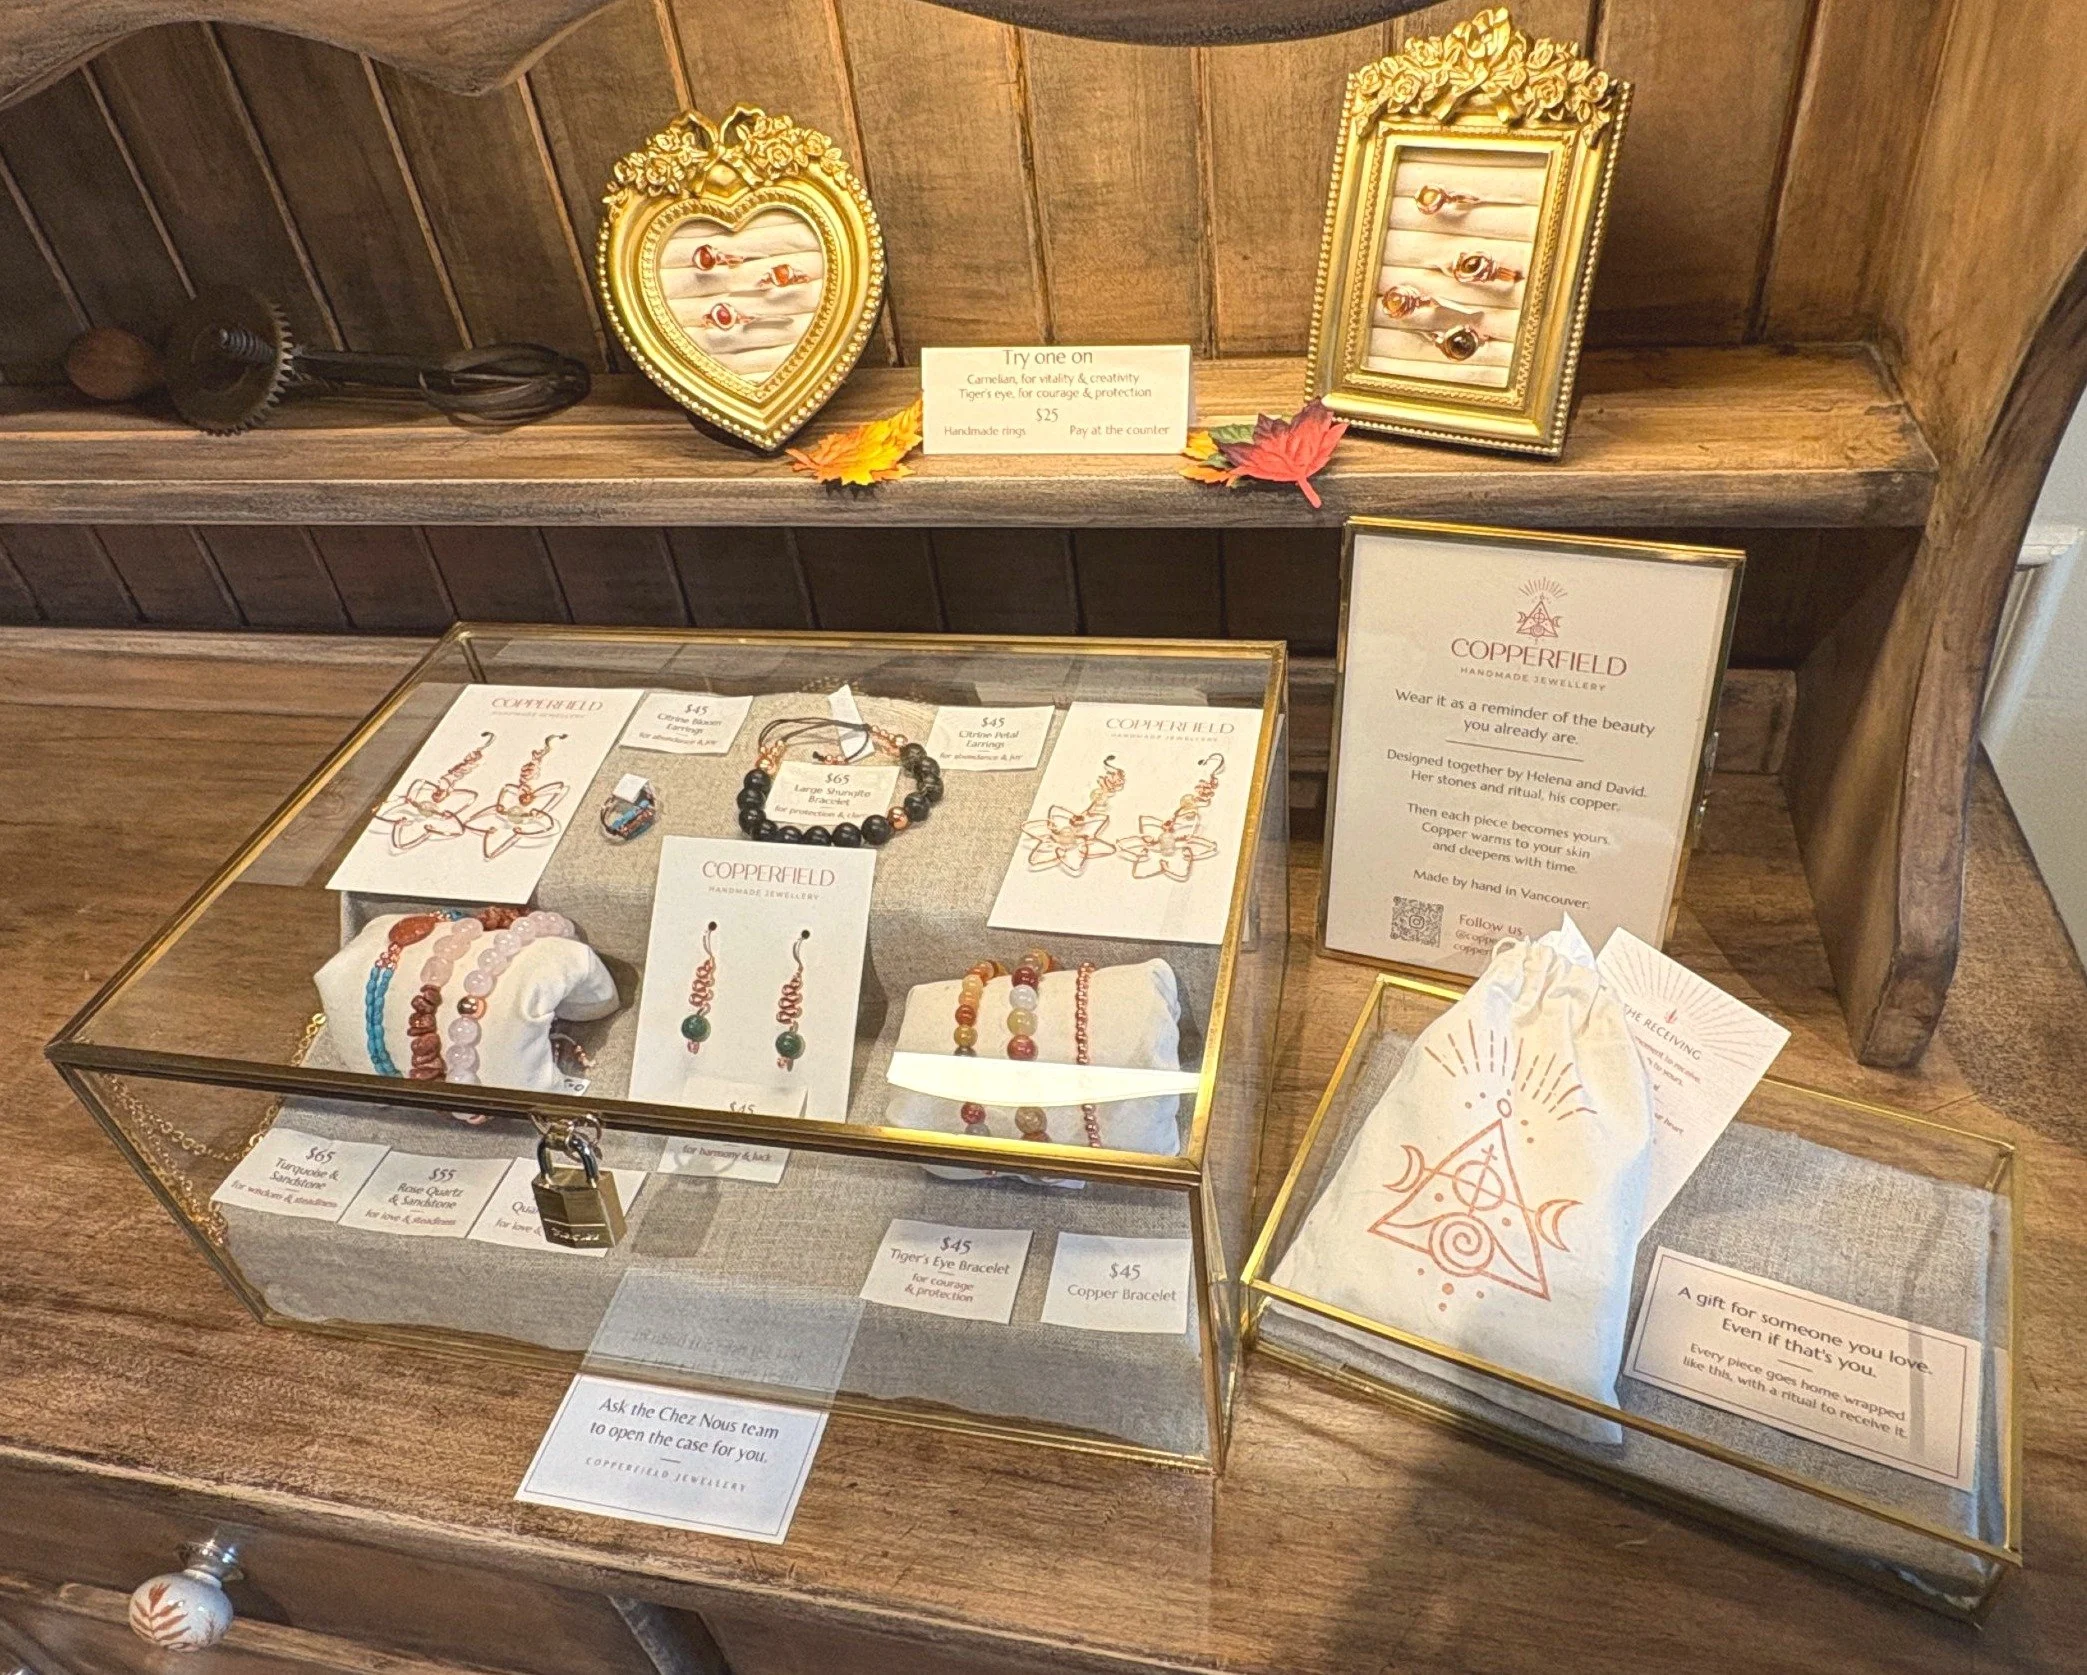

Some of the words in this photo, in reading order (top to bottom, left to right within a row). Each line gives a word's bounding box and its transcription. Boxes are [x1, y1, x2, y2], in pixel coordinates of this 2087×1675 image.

[1003, 350, 1030, 369] Try
[1035, 354, 1066, 364] one
[1071, 352, 1093, 364] on
[1021, 374, 1035, 384] for
[1040, 374, 1074, 385] vitality
[1078, 374, 1088, 384] &
[1090, 374, 1139, 384] creativity
[960, 389, 992, 402] Tiger's
[1019, 388, 1032, 398] for
[1037, 389, 1079, 399] courage
[1083, 388, 1093, 398] &
[1095, 388, 1151, 399] protection
[1036, 408, 1058, 423] $25
[944, 426, 998, 436] Handmade
[1002, 426, 1026, 437] rings
[1070, 425, 1088, 438] Pay
[1091, 427, 1102, 435] at
[1105, 425, 1122, 435] the
[1127, 426, 1169, 435] counter
[1451, 638, 1627, 677] COPPERFIELD
[1461, 666, 1528, 682] HANDMADE
[1534, 676, 1606, 691] JEWELLERY
[657, 713, 689, 723] Citrine
[684, 704, 708, 715] $45
[1395, 688, 1432, 704] Wear
[1437, 695, 1446, 707] it
[1450, 698, 1464, 709] as
[1468, 701, 1477, 711] a
[1482, 702, 1548, 721] reminder
[1553, 711, 1569, 724] of
[1573, 714, 1597, 728] the
[1602, 716, 1655, 737] beauty
[666, 724, 703, 735] Earrings
[981, 717, 1005, 728] $45
[1106, 718, 1235, 734] COPPERFIELD
[1464, 718, 1490, 732] you
[1494, 723, 1548, 743] already
[1552, 731, 1578, 745] are.
[966, 740, 1004, 749] Earrings
[825, 773, 850, 784] $65
[1387, 749, 1443, 767] Designed
[1447, 759, 1503, 776] together
[1507, 766, 1523, 781] by
[1527, 770, 1572, 787] Helena
[1576, 779, 1601, 791] and
[1606, 781, 1647, 798] David.
[794, 784, 823, 794] Large
[808, 796, 850, 805] Bracelet
[789, 808, 835, 817] protection
[1407, 802, 1437, 817] Then
[1441, 809, 1470, 822] each
[1474, 814, 1507, 829] piece
[1512, 819, 1568, 838] becomes
[1573, 830, 1611, 846] yours.
[703, 861, 835, 886] COPPERFIELD
[708, 886, 761, 896] HANDMADE
[765, 890, 819, 900] JEWELLERY
[1413, 869, 1448, 885] Made
[1452, 875, 1468, 889] by
[1470, 879, 1501, 894] hand
[1505, 884, 1516, 895] in
[1521, 887, 1590, 909] Vancouver.
[1460, 914, 1503, 931] Follow
[1508, 925, 1522, 935] us
[1644, 1018, 1702, 1060] RECEIVING
[306, 1146, 336, 1164] $65
[683, 1145, 697, 1153] for
[699, 1146, 740, 1159] harmony
[741, 1152, 750, 1162] &
[752, 1151, 772, 1162] luck
[276, 1157, 327, 1178] Turquoise
[329, 1170, 339, 1180] &
[429, 1167, 456, 1182] $55
[270, 1171, 326, 1189] Sandstone
[231, 1180, 246, 1189] for
[284, 1194, 294, 1203] &
[398, 1183, 424, 1194] Rose
[426, 1187, 463, 1197] Quartz
[389, 1194, 399, 1206] &
[401, 1196, 457, 1209] Sandstone
[365, 1209, 379, 1217] for
[402, 1215, 411, 1224] &
[495, 1219, 510, 1228] for
[512, 1222, 533, 1232] love
[940, 1236, 971, 1254] $45
[889, 1248, 930, 1264] Tiger's
[933, 1256, 955, 1269] Eye
[959, 1261, 1010, 1275] Bracelet
[1109, 1264, 1140, 1281] $45
[912, 1273, 927, 1283] for
[930, 1277, 974, 1291] courage
[904, 1284, 916, 1294] &
[916, 1287, 973, 1302] protection
[1067, 1284, 1118, 1300] Copper
[1122, 1288, 1177, 1302] Bracelet
[1678, 1287, 1691, 1299] A
[1696, 1294, 1726, 1309] gift
[1731, 1302, 1756, 1318] for
[1761, 1313, 1843, 1347] someone
[1849, 1340, 1882, 1360] you
[1890, 1350, 1933, 1375] love.
[1722, 1318, 1762, 1340] Even
[1768, 1333, 1781, 1346] if
[1786, 1339, 1832, 1363] that's
[1838, 1356, 1876, 1378] you.
[1691, 1343, 1724, 1363] Every
[1727, 1358, 1763, 1374] piece
[1766, 1370, 1797, 1386] goes
[1801, 1379, 1839, 1399] home
[1844, 1394, 1905, 1421] wrapped
[1683, 1356, 1704, 1371] like
[1709, 1364, 1732, 1381] this,
[1738, 1376, 1765, 1392] with
[1769, 1387, 1777, 1395] a
[1781, 1390, 1816, 1408] ritual
[1821, 1402, 1836, 1415] to
[1840, 1410, 1890, 1432] receive
[1895, 1424, 1908, 1438] it.
[598, 1397, 625, 1413] Ask
[630, 1403, 656, 1418] the
[659, 1407, 696, 1426] Chez
[701, 1413, 736, 1432] Nous
[741, 1422, 779, 1439] team
[589, 1422, 606, 1435] to
[608, 1427, 645, 1443] open
[648, 1431, 673, 1447] the
[675, 1438, 709, 1453] case
[712, 1440, 735, 1456] for
[736, 1448, 767, 1463] you.
[585, 1457, 669, 1478] COPPERFIELD
[675, 1471, 747, 1492] JEWELLERY
